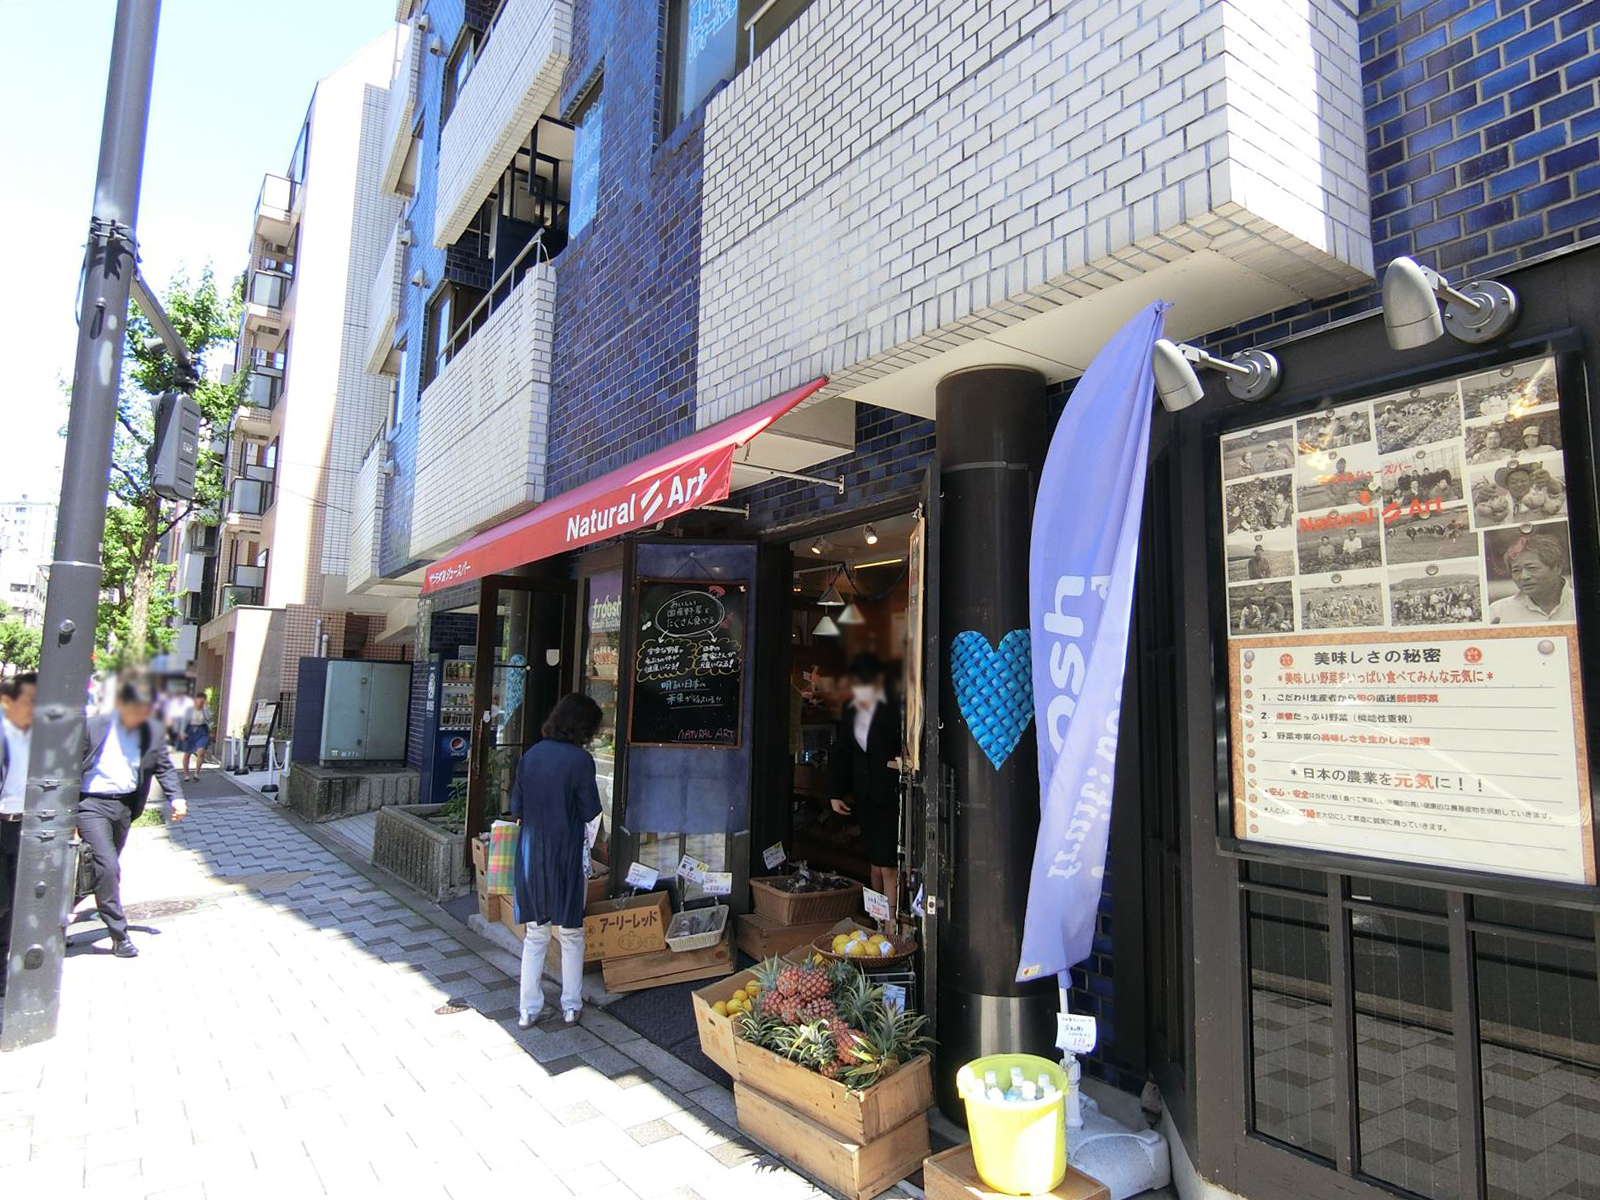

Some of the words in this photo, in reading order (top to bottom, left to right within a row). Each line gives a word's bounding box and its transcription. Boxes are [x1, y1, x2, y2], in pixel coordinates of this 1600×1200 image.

[566, 493, 636, 542] Natural
[667, 467, 708, 508] Art
[1299, 507, 1374, 533] Natural
[1409, 496, 1442, 517] Art
[1314, 647, 1442, 665] 美味しさの秘密
[600, 910, 658, 934] アーリーレッド
